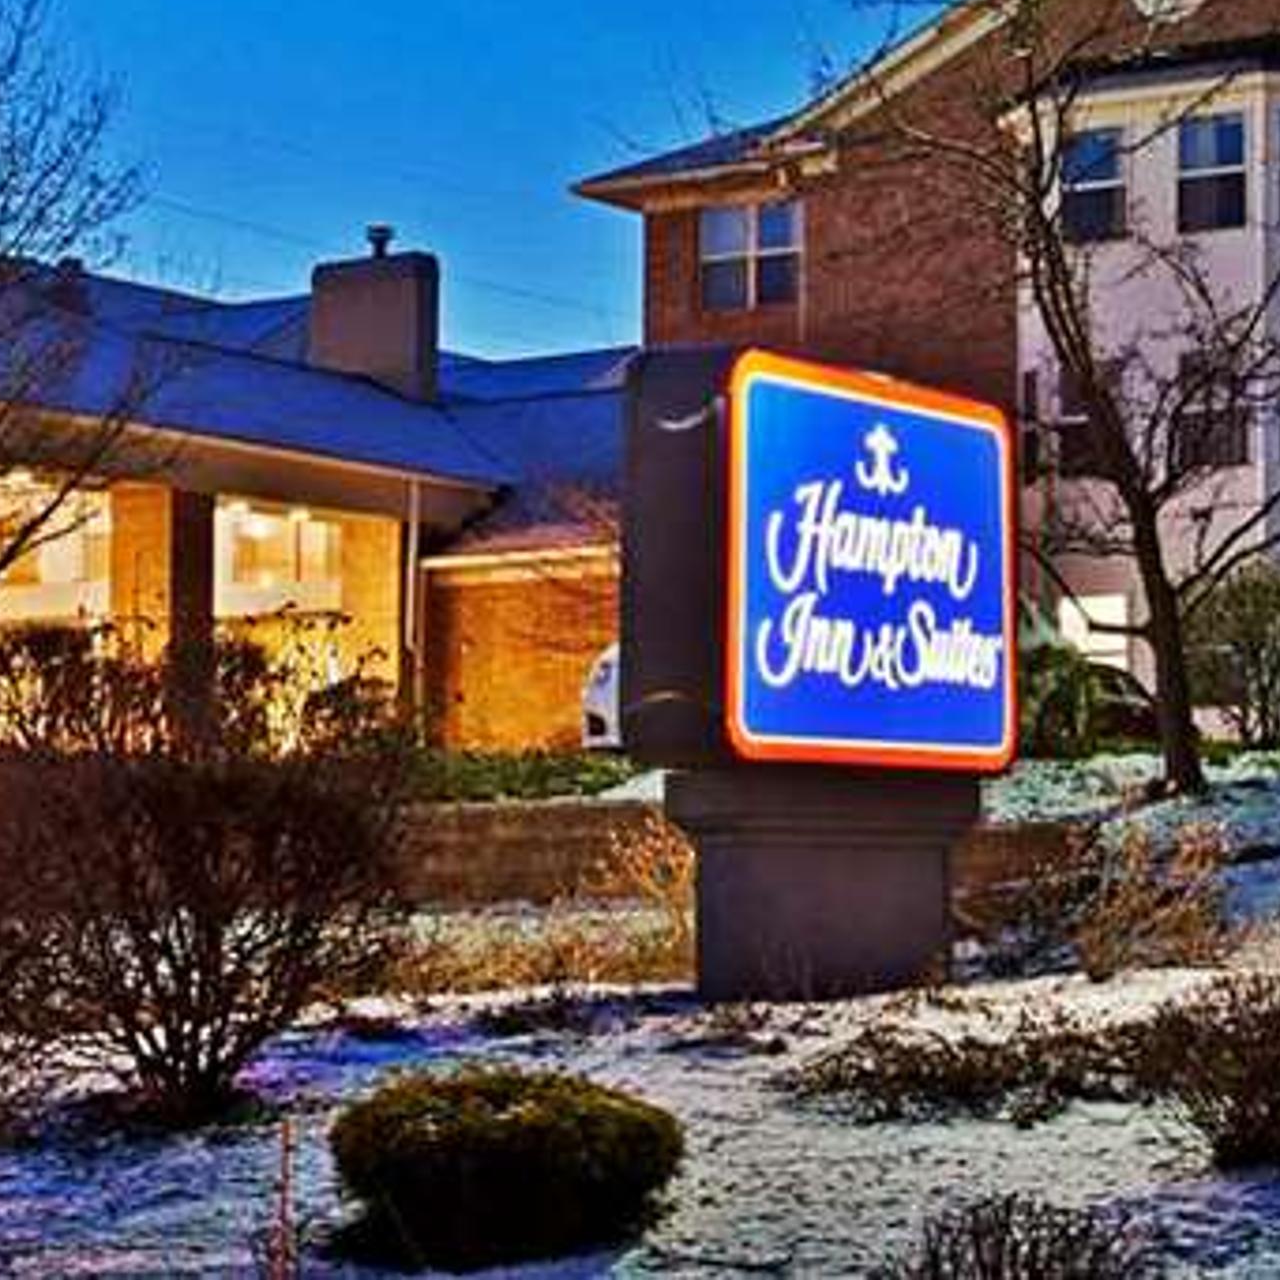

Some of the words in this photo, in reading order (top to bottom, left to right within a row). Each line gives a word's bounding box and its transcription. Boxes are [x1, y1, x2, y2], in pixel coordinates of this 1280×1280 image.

[765, 479, 978, 599] Hampton
[756, 592, 872, 687] Inn
[869, 623, 899, 690] &
[895, 600, 1004, 689] Suites
